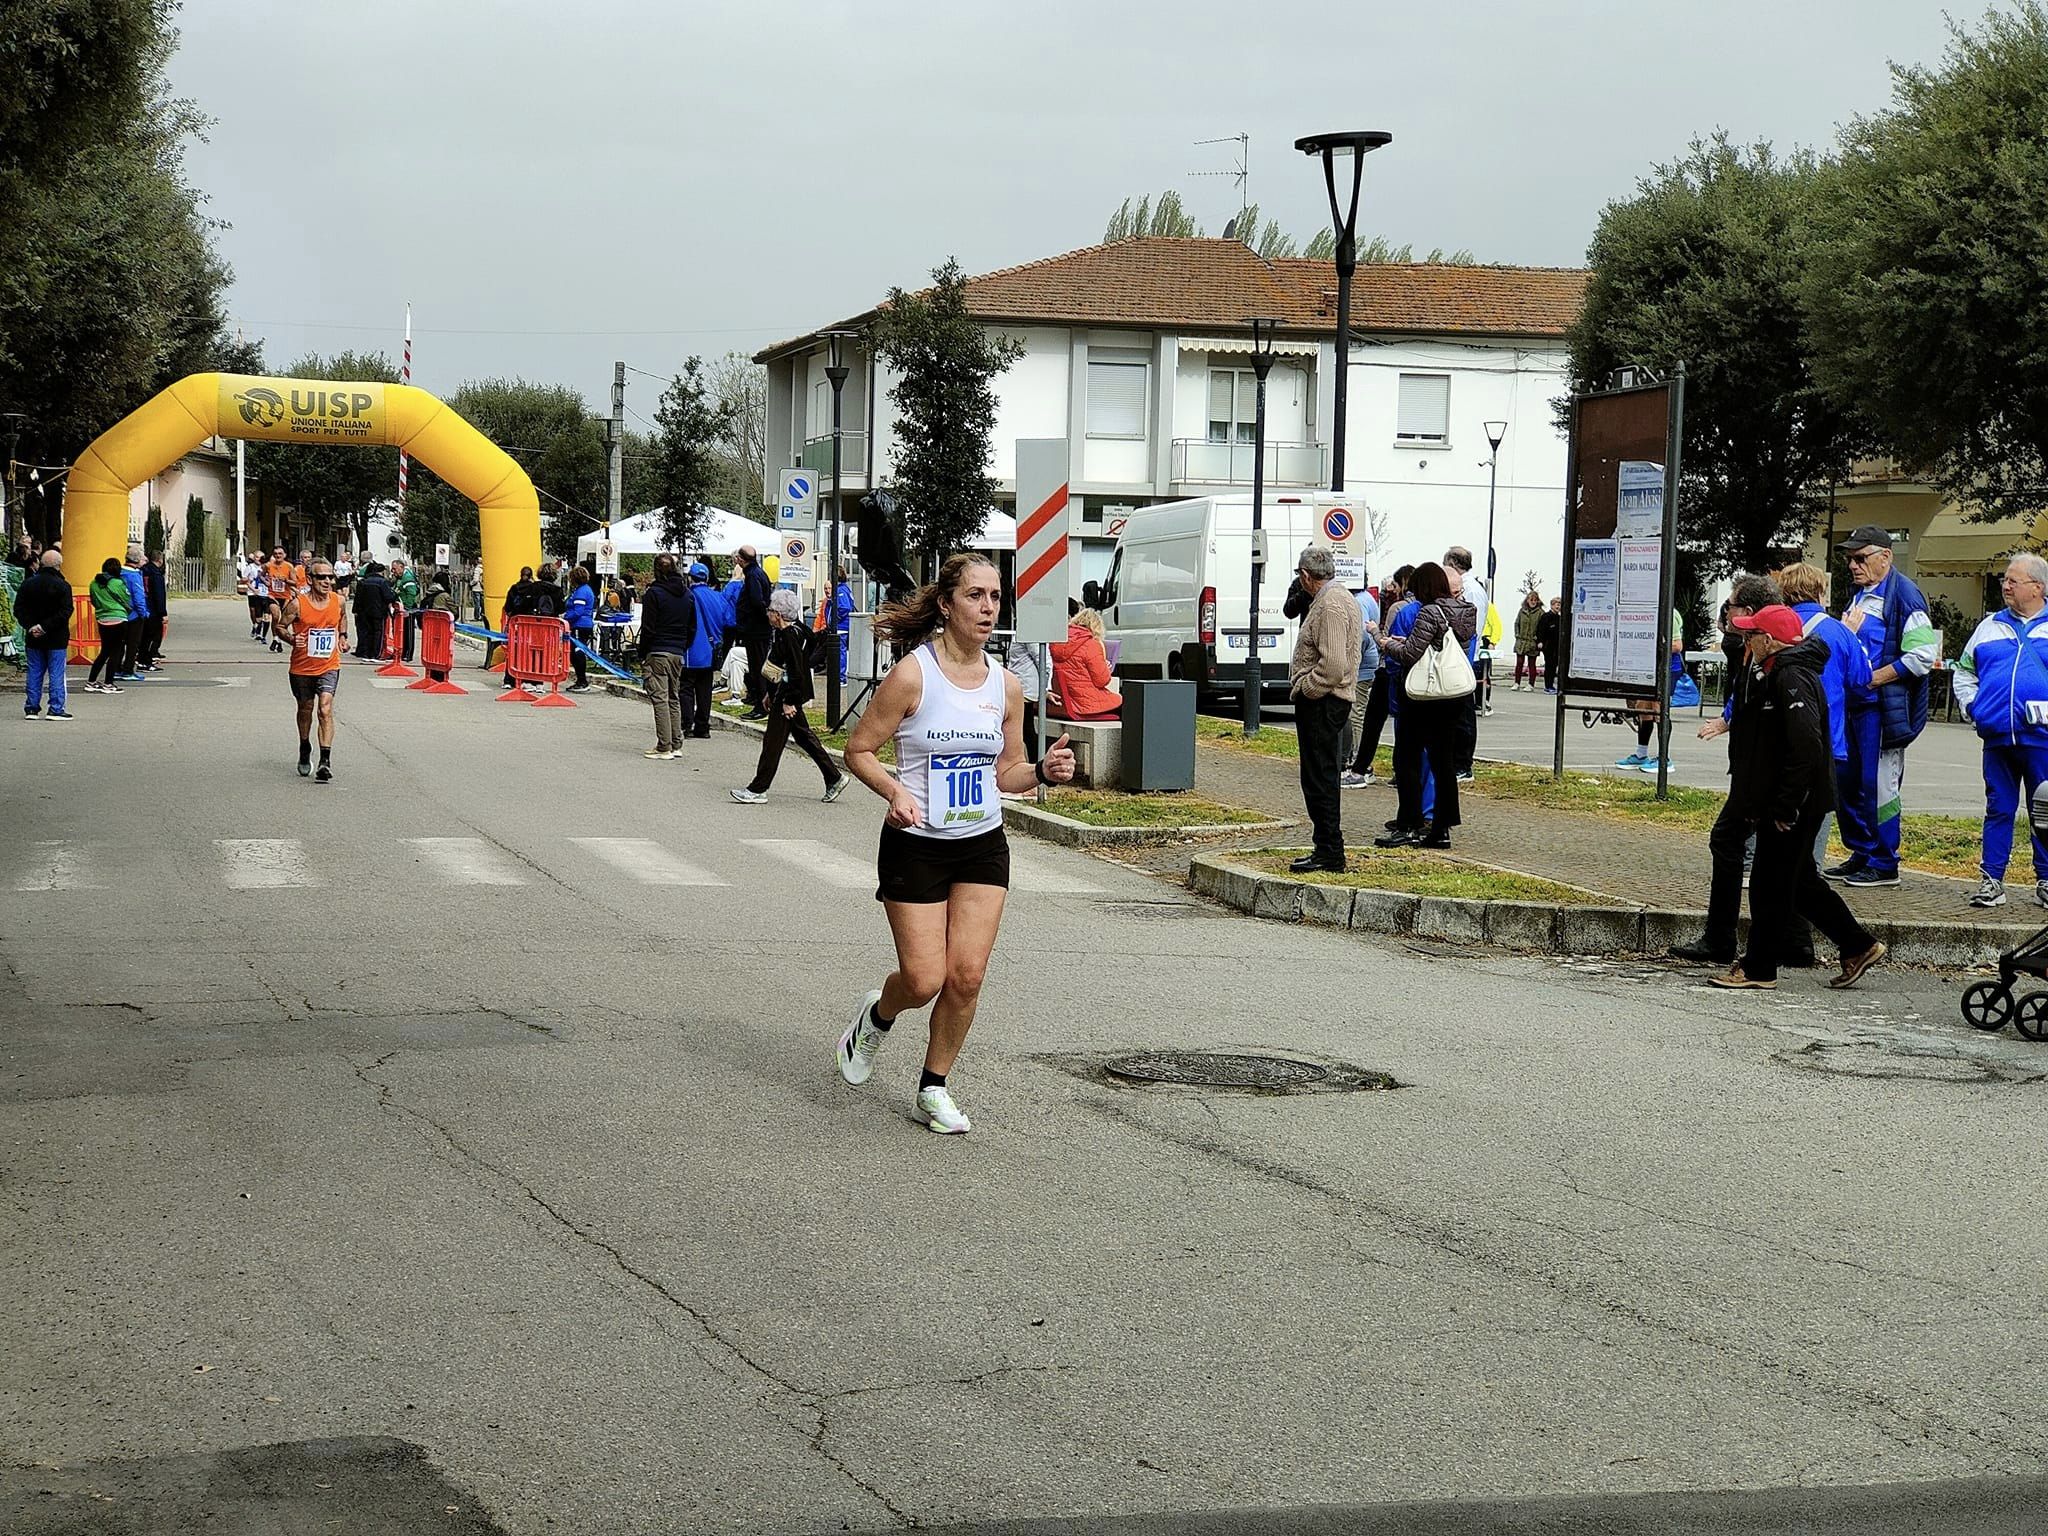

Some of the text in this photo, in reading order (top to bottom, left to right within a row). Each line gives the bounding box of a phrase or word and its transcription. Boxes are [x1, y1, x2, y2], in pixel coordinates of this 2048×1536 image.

[291, 390, 372, 418] UISP
[291, 417, 372, 429] UNIONE ITALIANA
[1620, 489, 1662, 508] Ivan Alvisi
[1624, 545, 1659, 553] RINGRAZIAMENTO
[1623, 562, 1658, 571] NARDI NATALIA
[1577, 613, 1612, 621] RINGRAZIAMENTO
[1620, 613, 1655, 621] RINGRAZIAMENTO
[1577, 628, 1611, 639] ALVISI IVAN
[315, 636, 332, 650] 182
[927, 729, 995, 741] lughesina
[946, 770, 983, 808] 106
